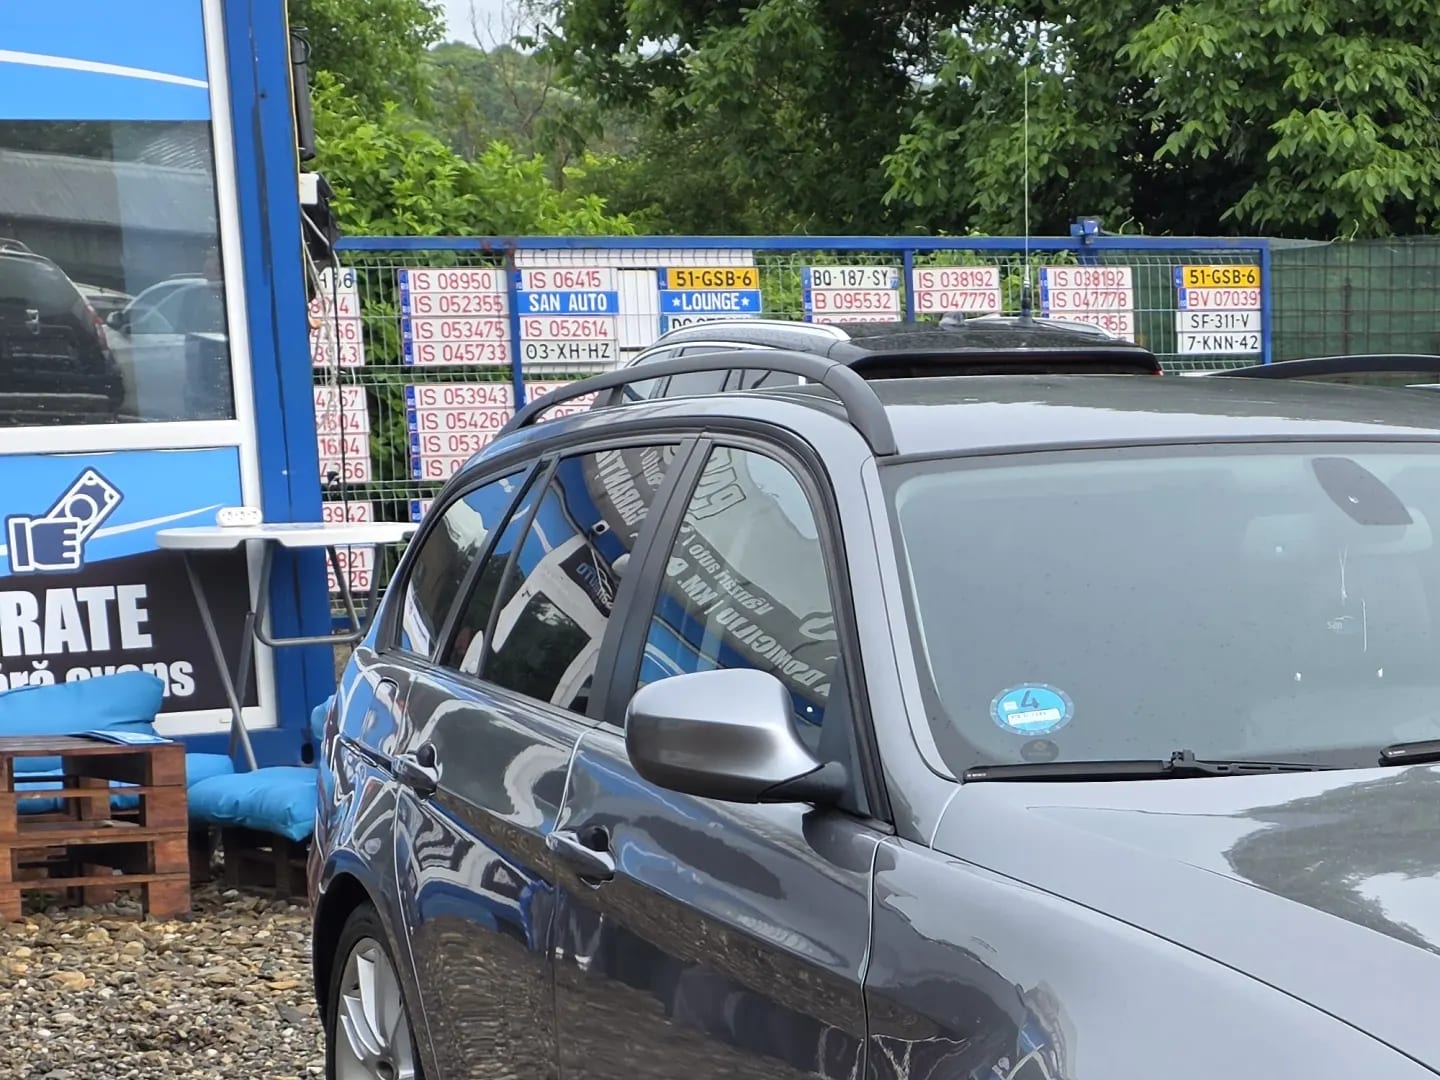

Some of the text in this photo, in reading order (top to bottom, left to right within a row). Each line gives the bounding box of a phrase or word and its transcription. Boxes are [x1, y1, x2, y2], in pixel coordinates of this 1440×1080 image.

[412, 272, 492, 290] IS 08950
[529, 270, 601, 289] IS 06415
[676, 270, 752, 287] 51-GSB-6
[918, 271, 934, 289] IS
[940, 270, 993, 289] 038192
[1053, 270, 1125, 288] IS 038192
[1189, 269, 1256, 285] 51-GSB-6
[414, 295, 503, 313] IS 052355
[529, 293, 607, 312] SAN AUTO
[681, 292, 741, 311] LOUNGE
[814, 291, 892, 310] B 095532
[918, 292, 996, 310] IS 047778
[1052, 291, 1128, 309] IS 047778
[1188, 290, 1261, 307] BV 07039
[415, 320, 505, 340] IS 053475
[524, 320, 608, 338] IS 052614
[1190, 313, 1250, 329] SF-311-V
[526, 342, 611, 360] 03-XH-HZ
[1187, 334, 1259, 351] 7-KNN-42
[418, 343, 507, 363] IS 045733
[419, 386, 508, 407] IS 053943
[421, 412, 439, 431] IS
[423, 435, 441, 453] IS
[426, 459, 443, 477] IS
[0, 583, 153, 657] RATE
[1021, 690, 1040, 709] 4
